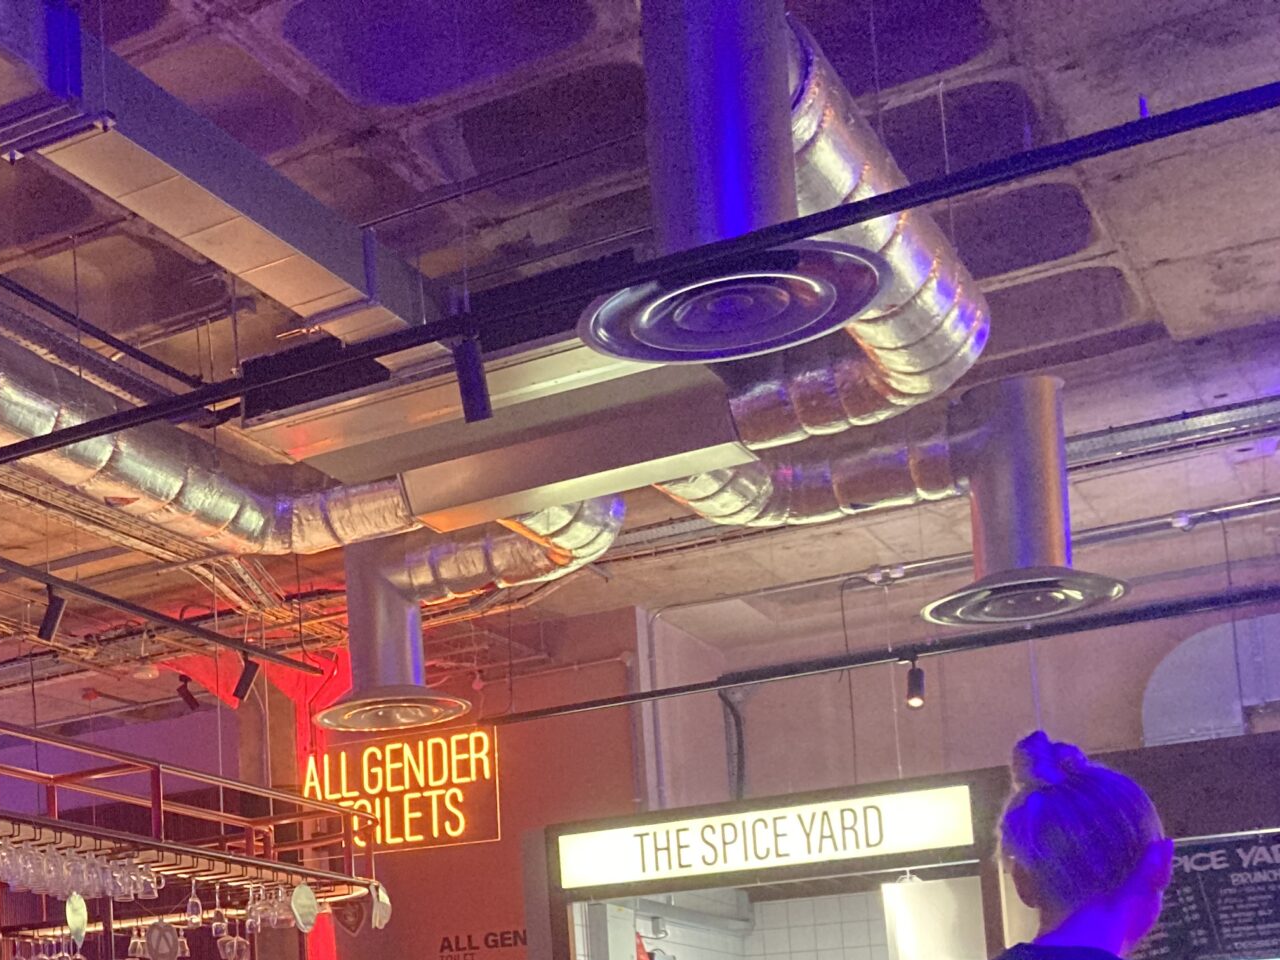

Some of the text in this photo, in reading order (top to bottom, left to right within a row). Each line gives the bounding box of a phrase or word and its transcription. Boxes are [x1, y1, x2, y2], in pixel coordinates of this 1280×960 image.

[304, 731, 490, 802] ALL GENDER
[633, 805, 885, 874] THE SPICE YARD
[439, 929, 528, 953] ALL GEN
